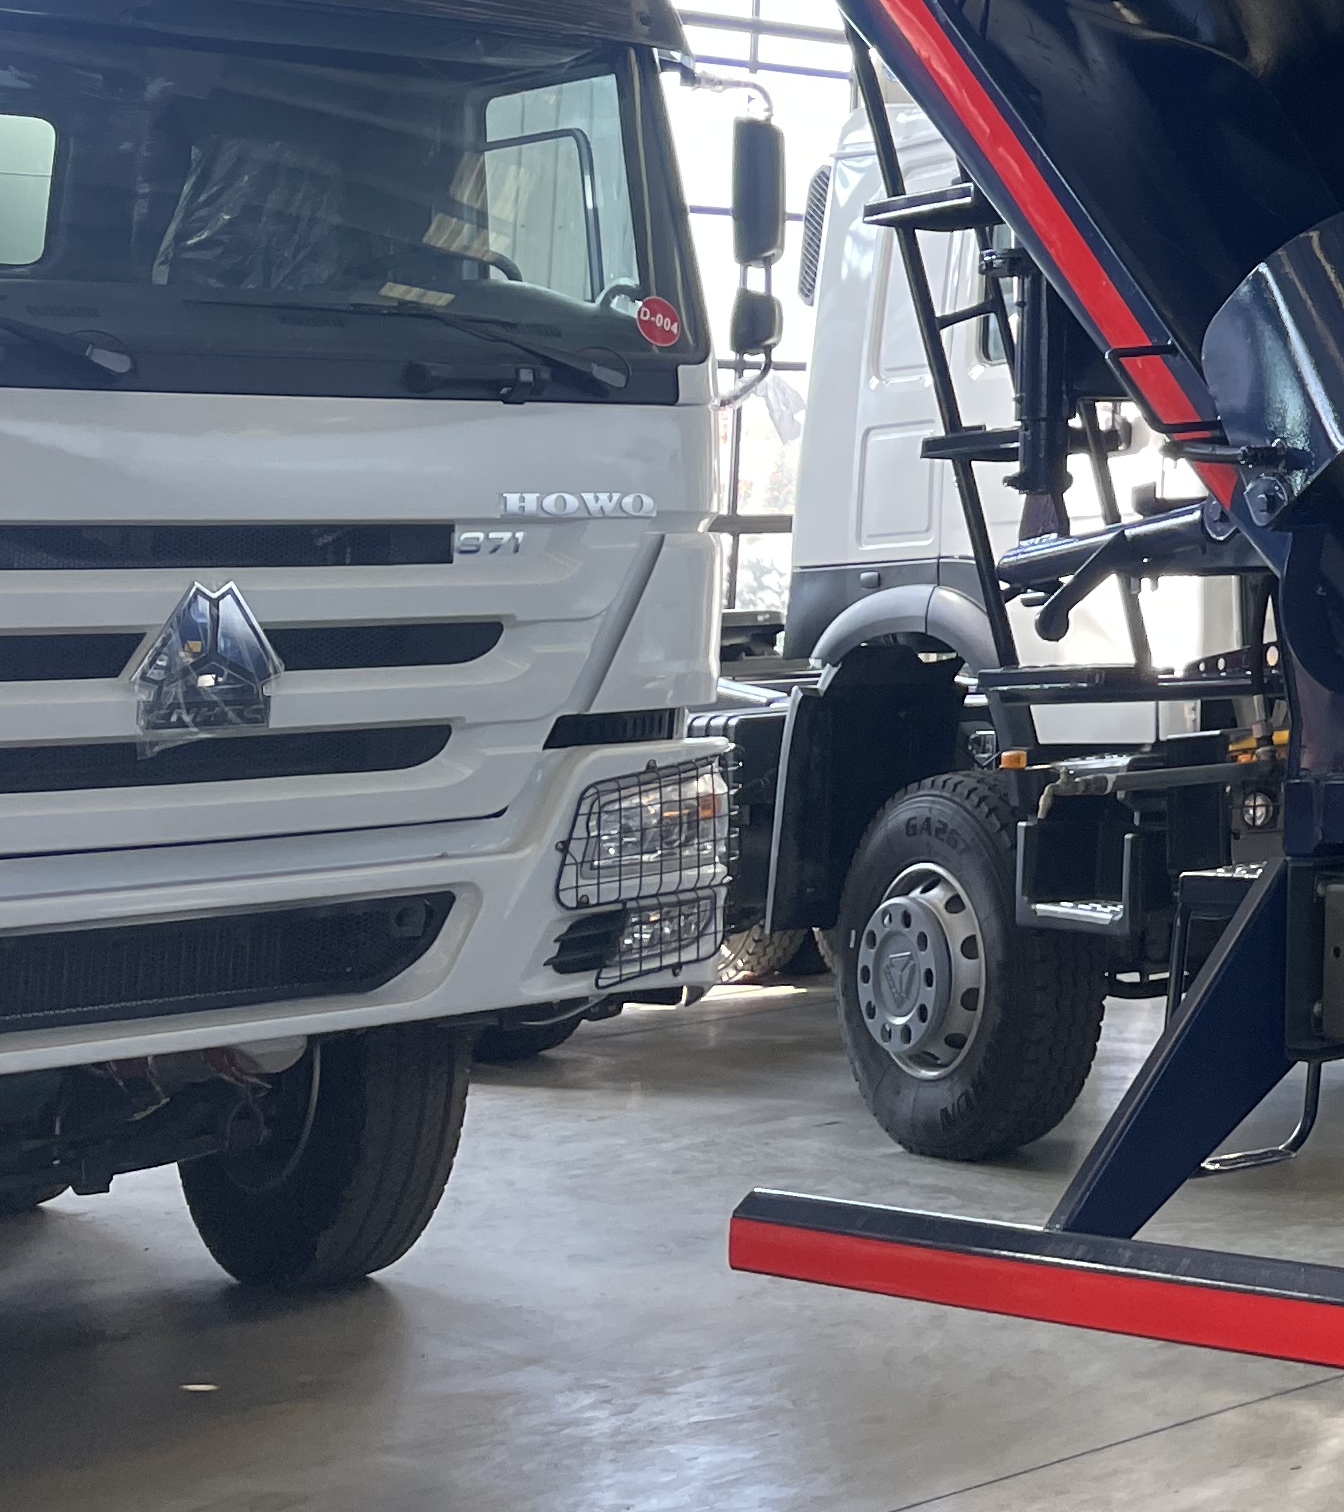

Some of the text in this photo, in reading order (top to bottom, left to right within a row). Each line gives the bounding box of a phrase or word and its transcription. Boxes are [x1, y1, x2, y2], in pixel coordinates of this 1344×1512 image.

[640, 306, 678, 335] D-004
[502, 492, 655, 516] HOWO
[456, 531, 525, 554] 371
[905, 815, 972, 856] GA267
